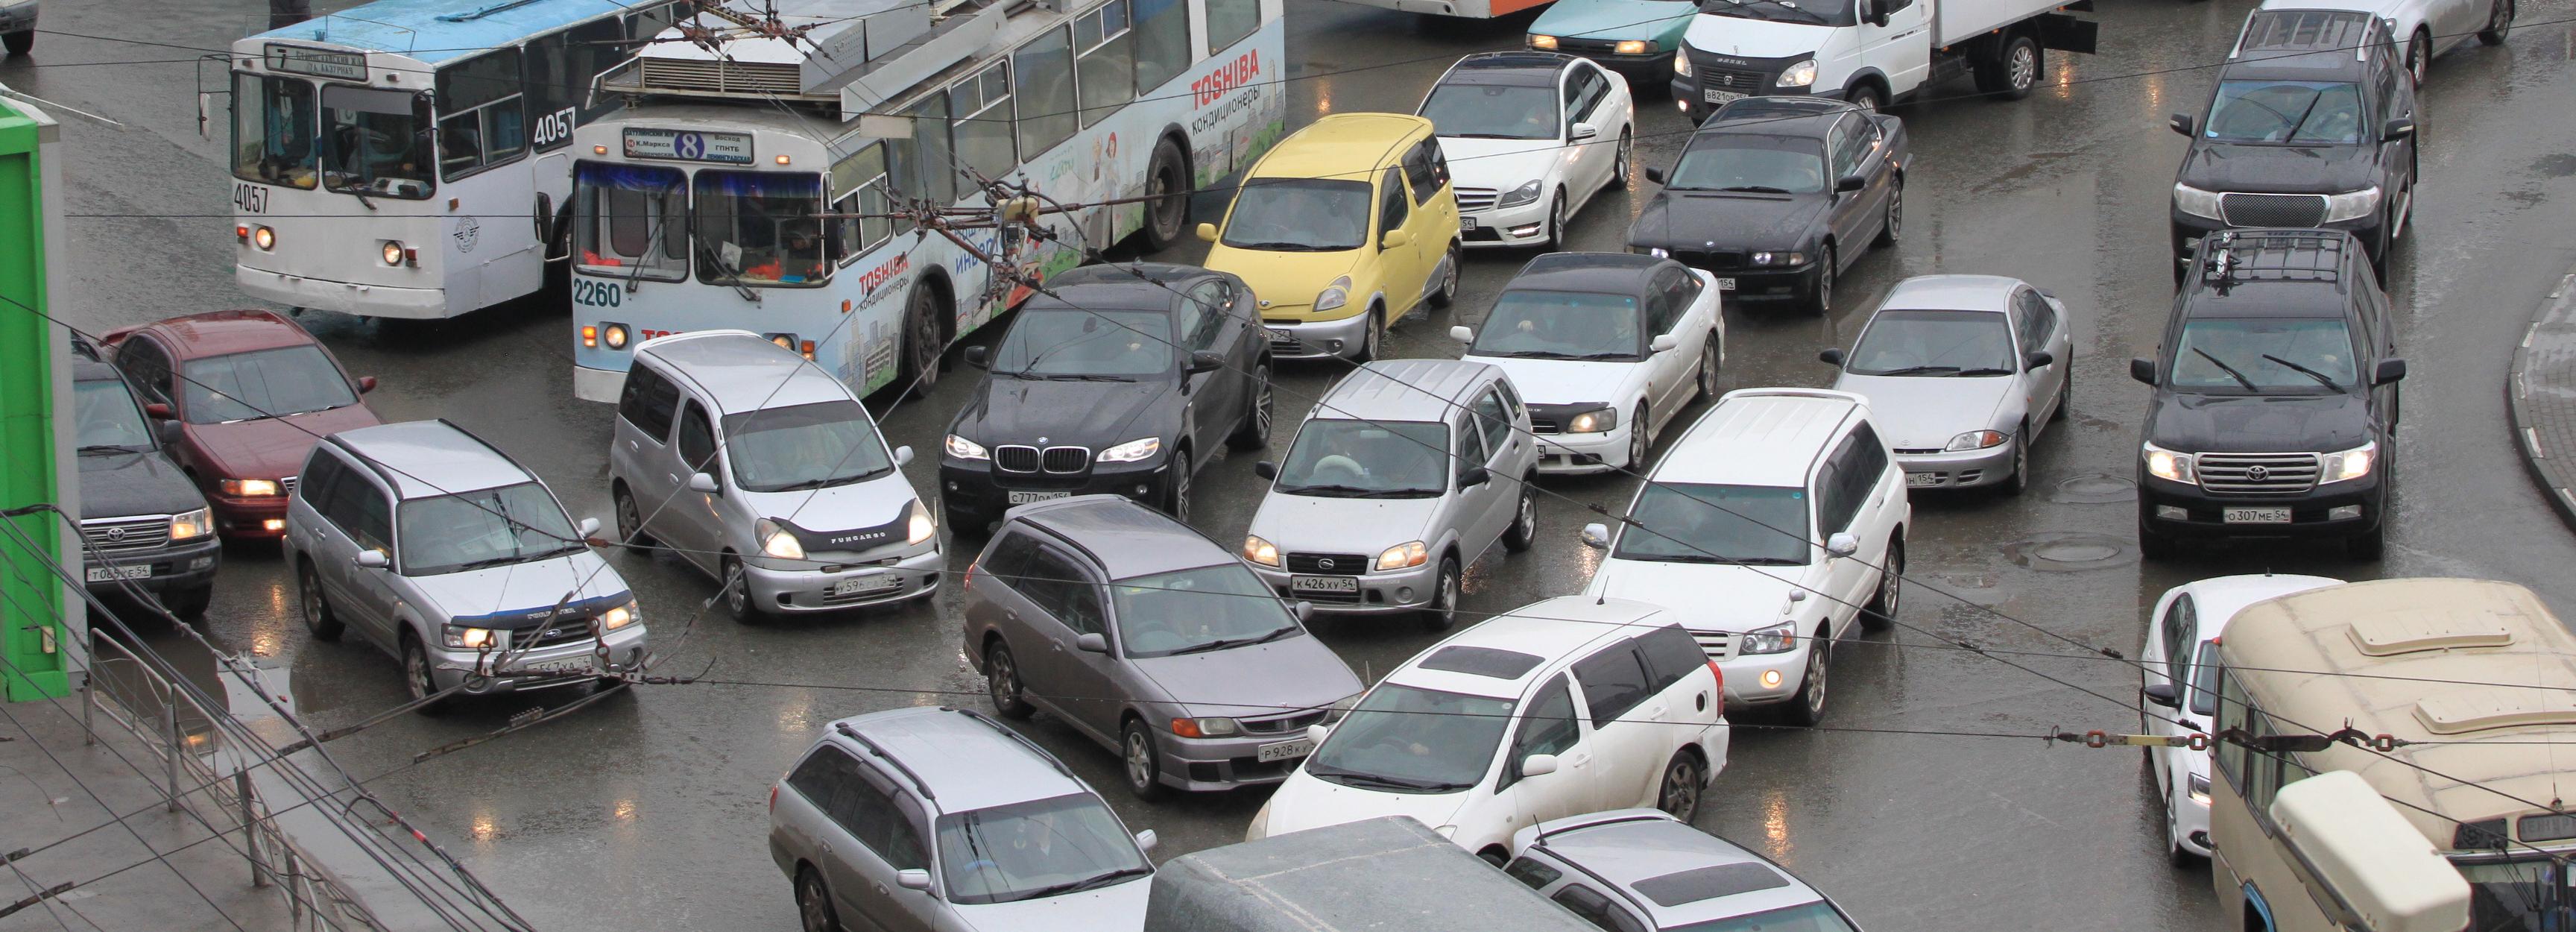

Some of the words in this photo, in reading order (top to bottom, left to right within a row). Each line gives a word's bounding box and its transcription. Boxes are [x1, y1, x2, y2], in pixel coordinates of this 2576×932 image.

[277, 48, 287, 69] 7
[1191, 48, 1260, 110] TOSHIBA
[534, 106, 575, 145] 4057
[1192, 84, 1260, 136] кондиционеры
[681, 133, 699, 158] 8
[716, 145, 740, 153] ГПНТБ
[234, 183, 268, 214] 4057
[859, 254, 909, 296] TOSHIBA
[573, 278, 621, 307] 2260
